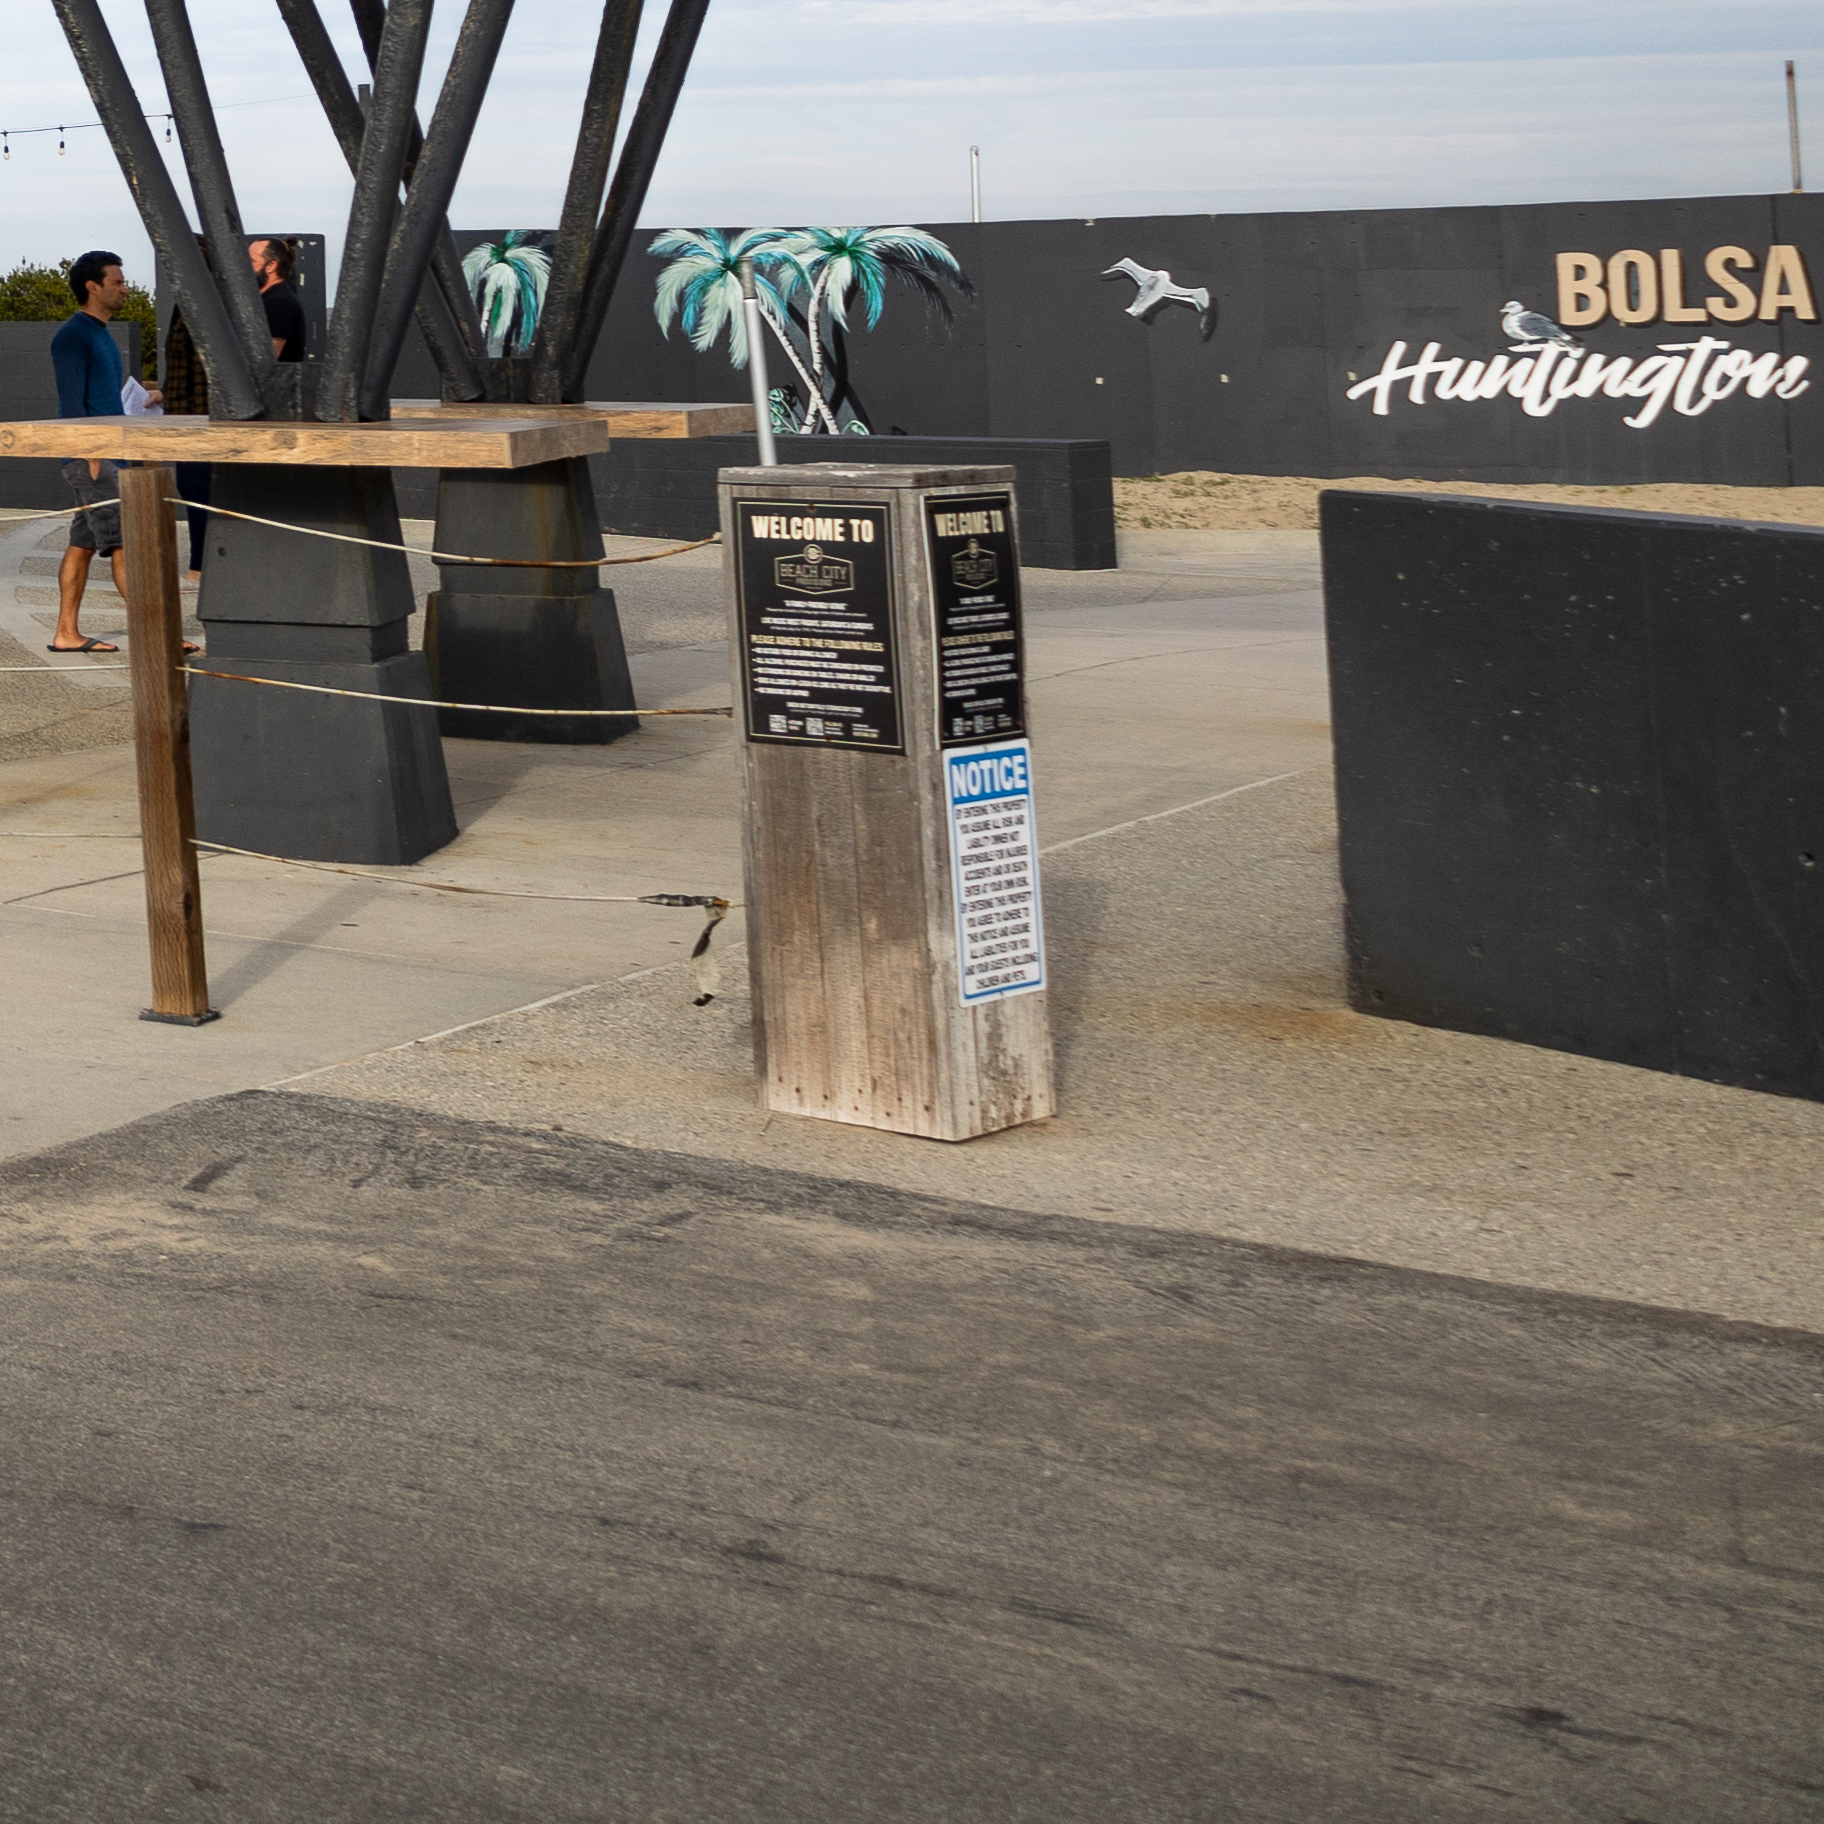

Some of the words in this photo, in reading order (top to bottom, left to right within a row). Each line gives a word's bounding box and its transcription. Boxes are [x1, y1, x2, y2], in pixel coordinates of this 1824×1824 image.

[1556, 245, 1816, 326] BOLSA
[1346, 336, 1810, 428] Huntington
[750, 515, 845, 541] WELCOME
[849, 519, 874, 543] TO
[933, 511, 990, 537] WELCOME
[990, 510, 1005, 533] TO
[780, 563, 819, 578] BEACH
[822, 565, 848, 580] CITY
[952, 755, 1027, 798] NOTICE
